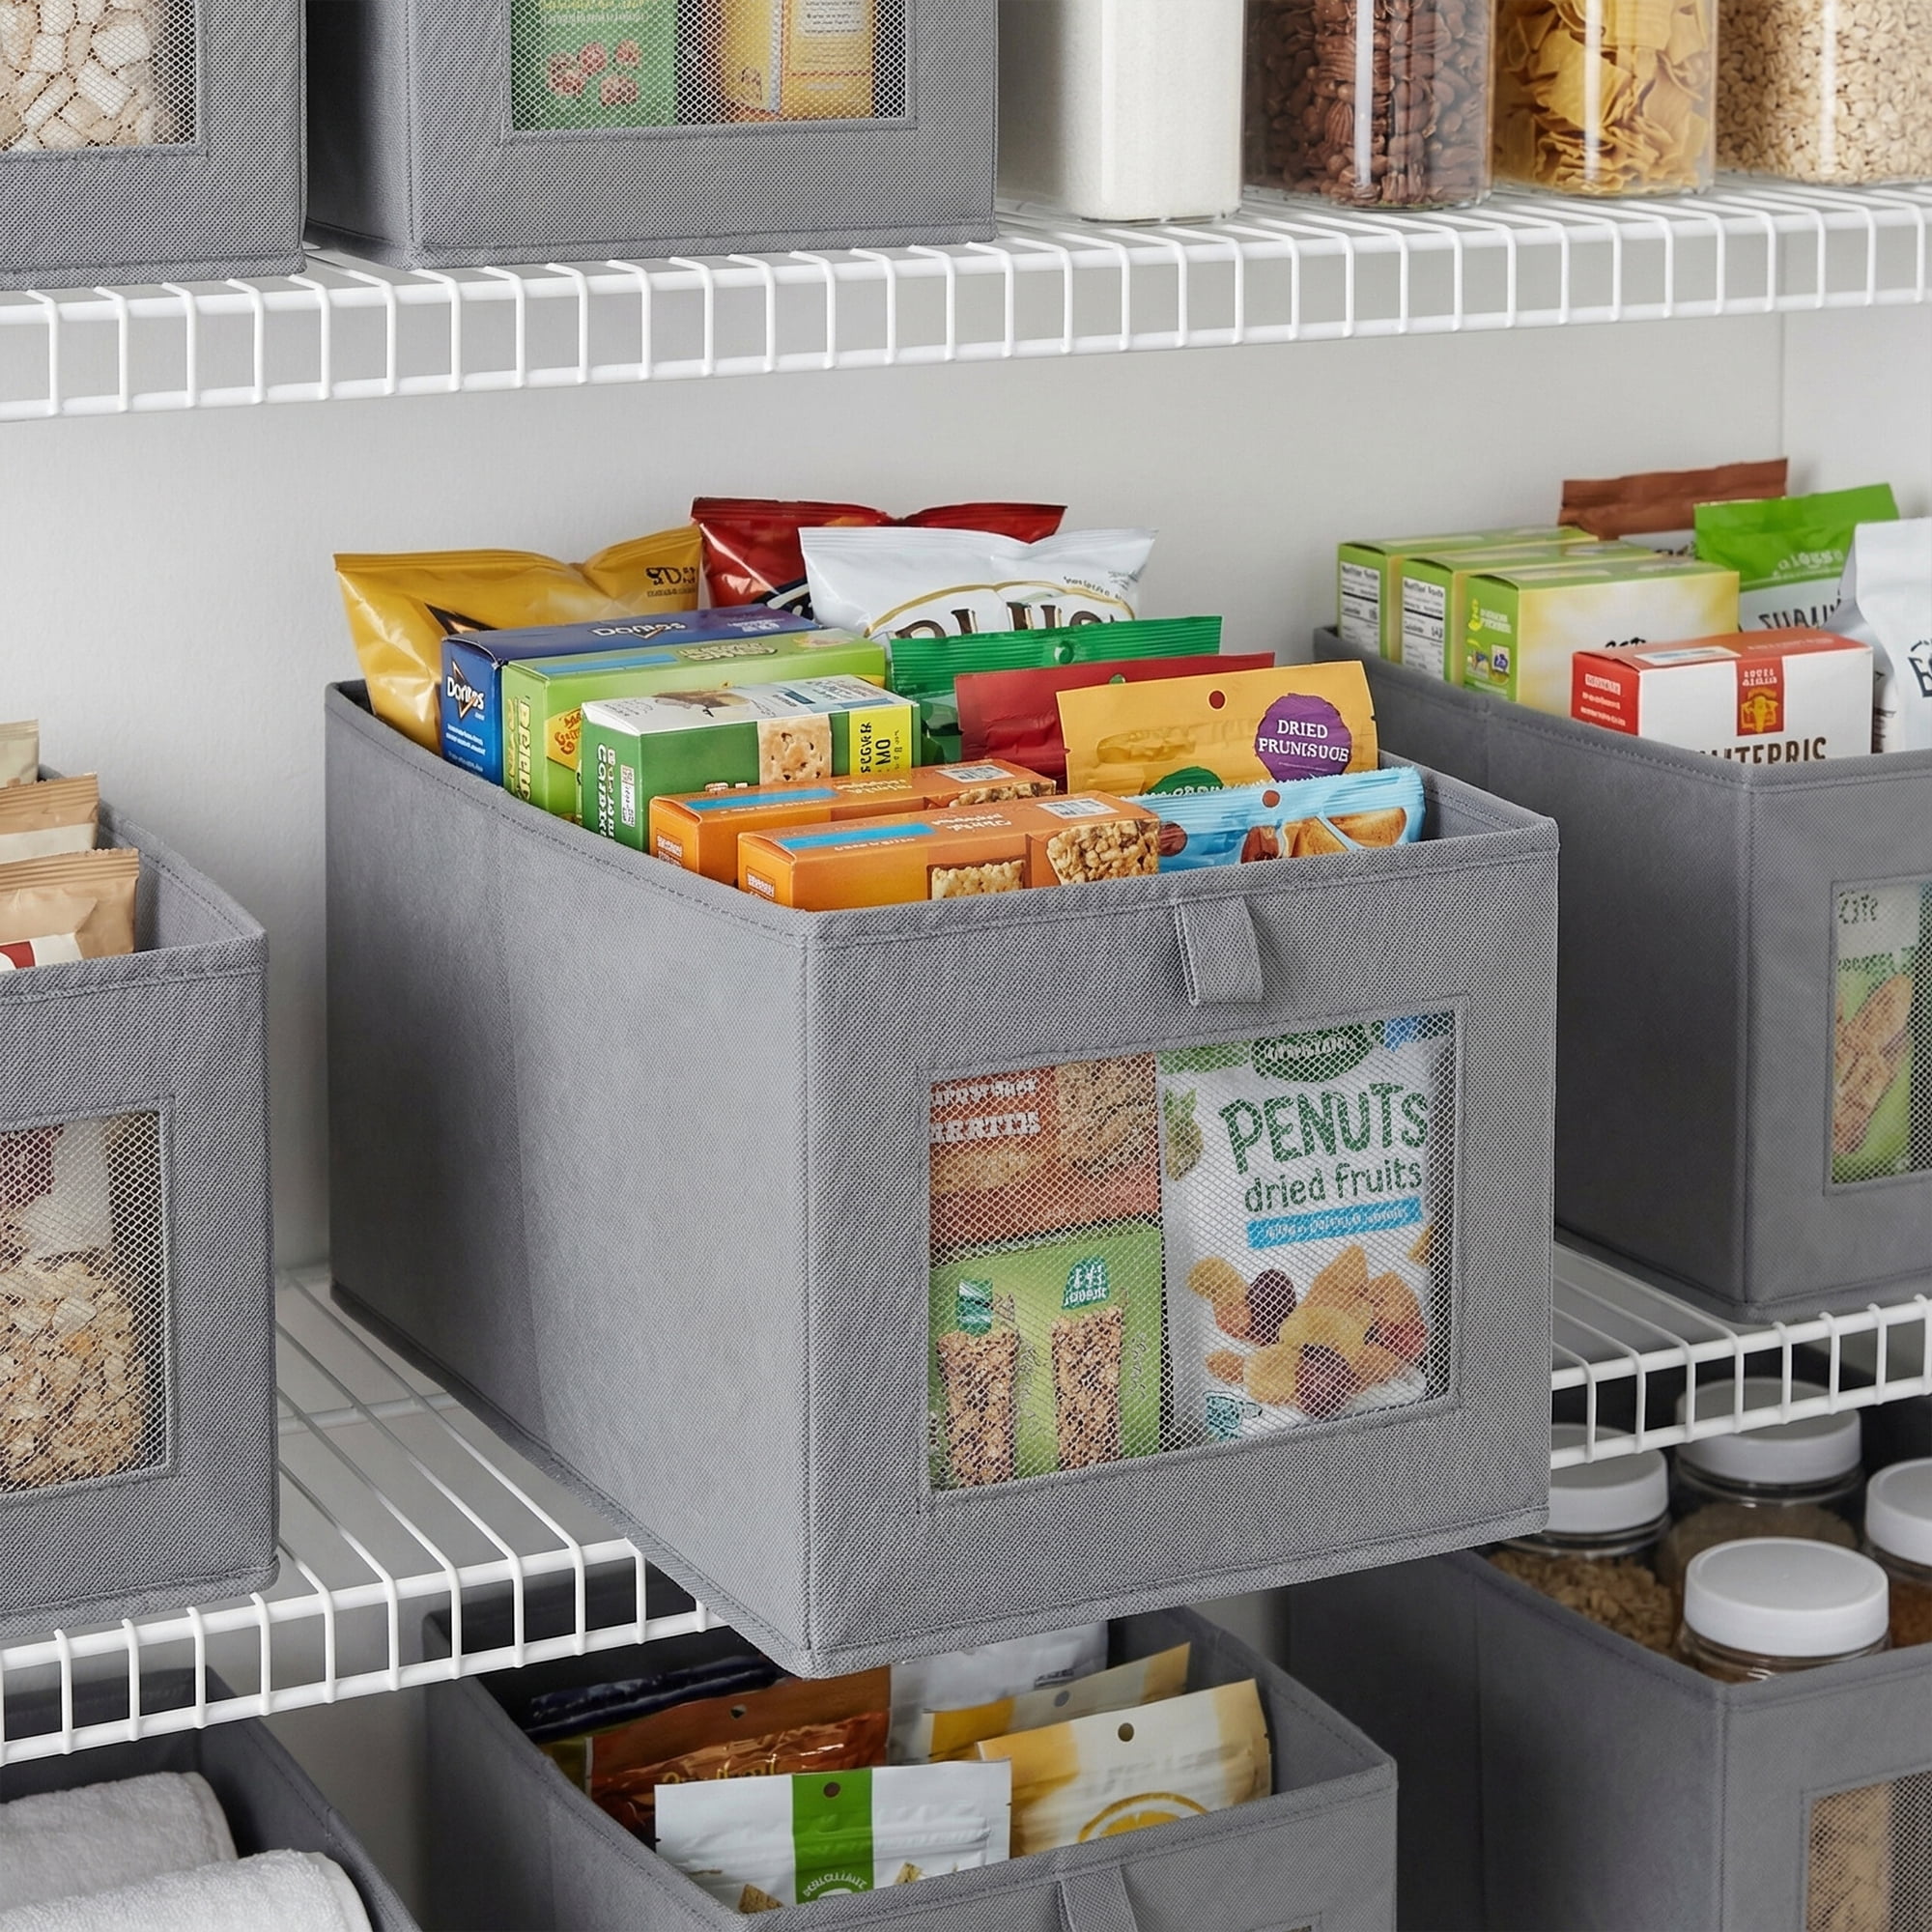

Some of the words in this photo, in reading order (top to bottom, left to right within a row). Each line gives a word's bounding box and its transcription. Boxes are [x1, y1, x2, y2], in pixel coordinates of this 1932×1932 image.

[1276, 719, 1328, 739] DRIED
[1218, 1082, 1429, 1176] PENUTS
[1244, 1167, 1326, 1213] dried
[1335, 1157, 1423, 1200] fruits
